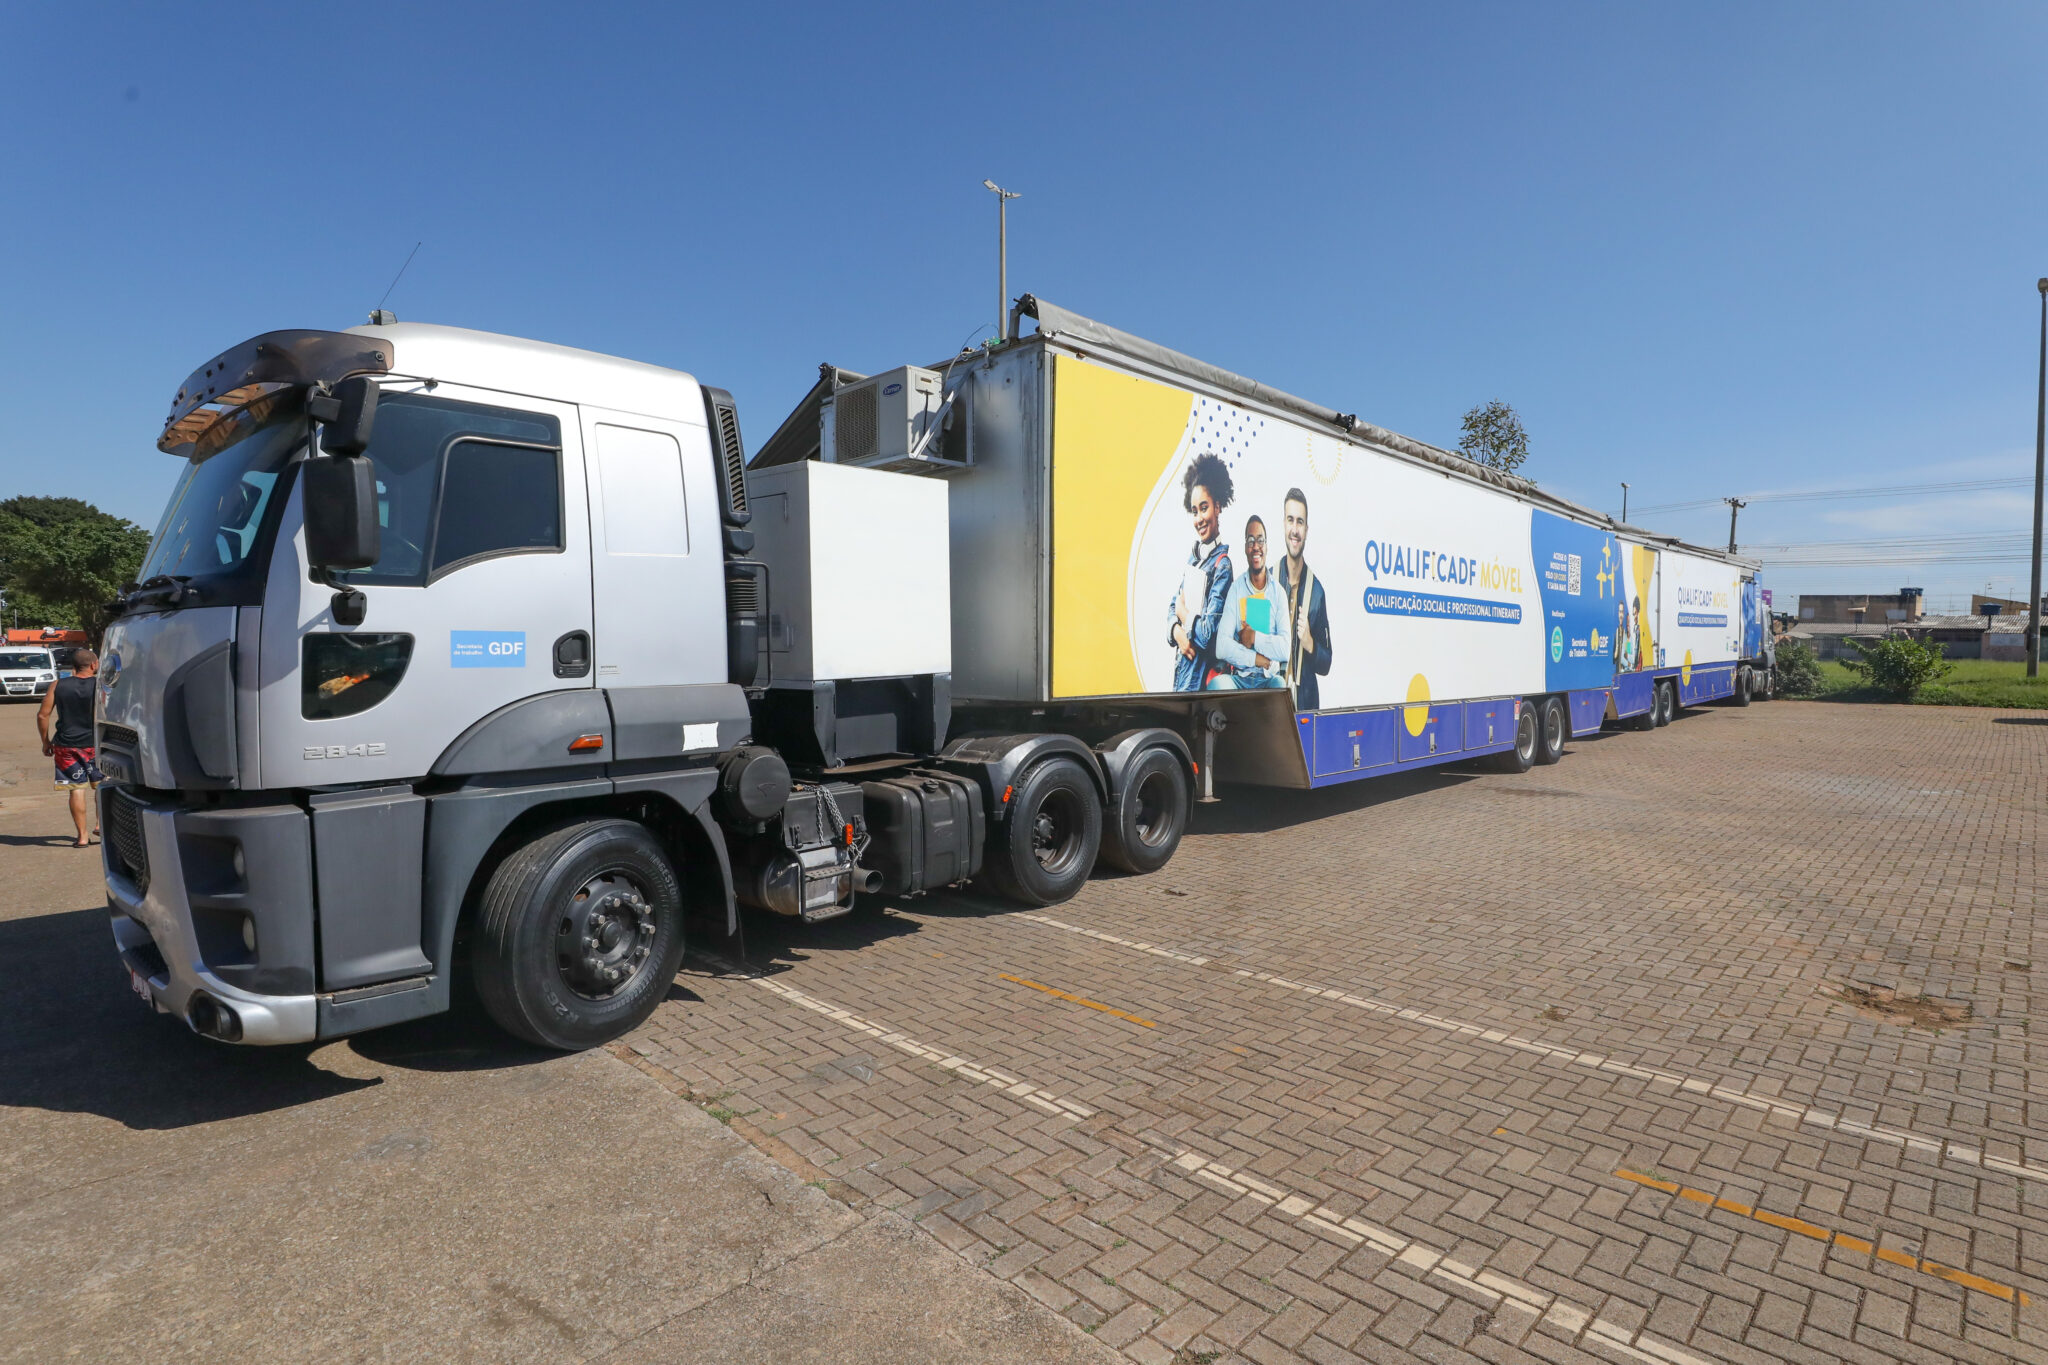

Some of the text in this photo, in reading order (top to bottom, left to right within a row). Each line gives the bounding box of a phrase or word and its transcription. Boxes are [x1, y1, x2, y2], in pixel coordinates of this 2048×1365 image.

[1365, 539, 1523, 593] QUALIFICADF MÓVEL
[1367, 594, 1520, 620] QUALIFICAÇÃO SOCIAL E PROFISSIONAL ITINERANTE
[488, 641, 524, 656] GDF
[303, 743, 386, 760] 2842
